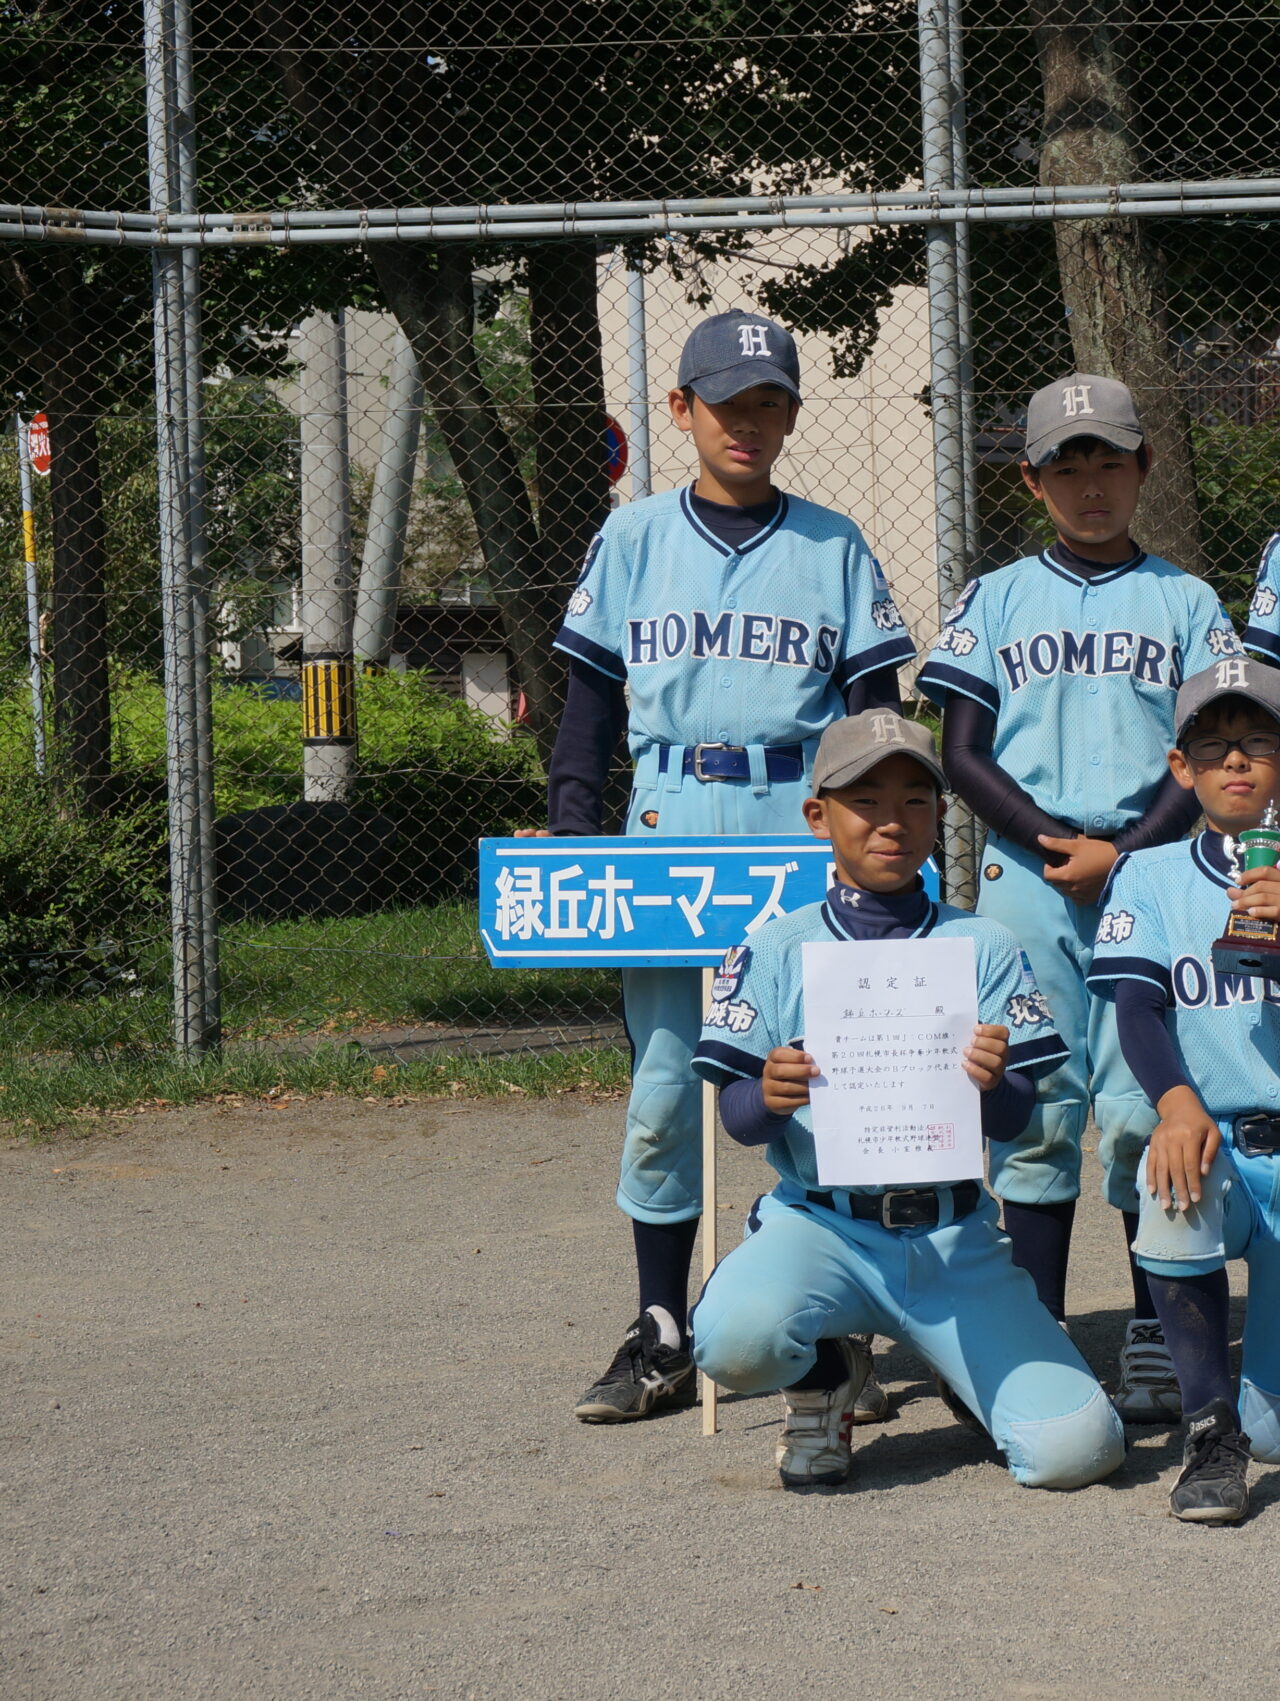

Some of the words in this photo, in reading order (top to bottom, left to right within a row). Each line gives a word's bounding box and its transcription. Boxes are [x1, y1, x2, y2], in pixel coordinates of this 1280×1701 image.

[738, 325, 772, 357] H
[1063, 385, 1095, 417] H
[627, 611, 840, 674] HOMERS
[998, 630, 1184, 693] HOMERS
[1215, 659, 1250, 688] H
[870, 714, 906, 744] H
[494, 863, 800, 941] 緑丘ホーマーズ
